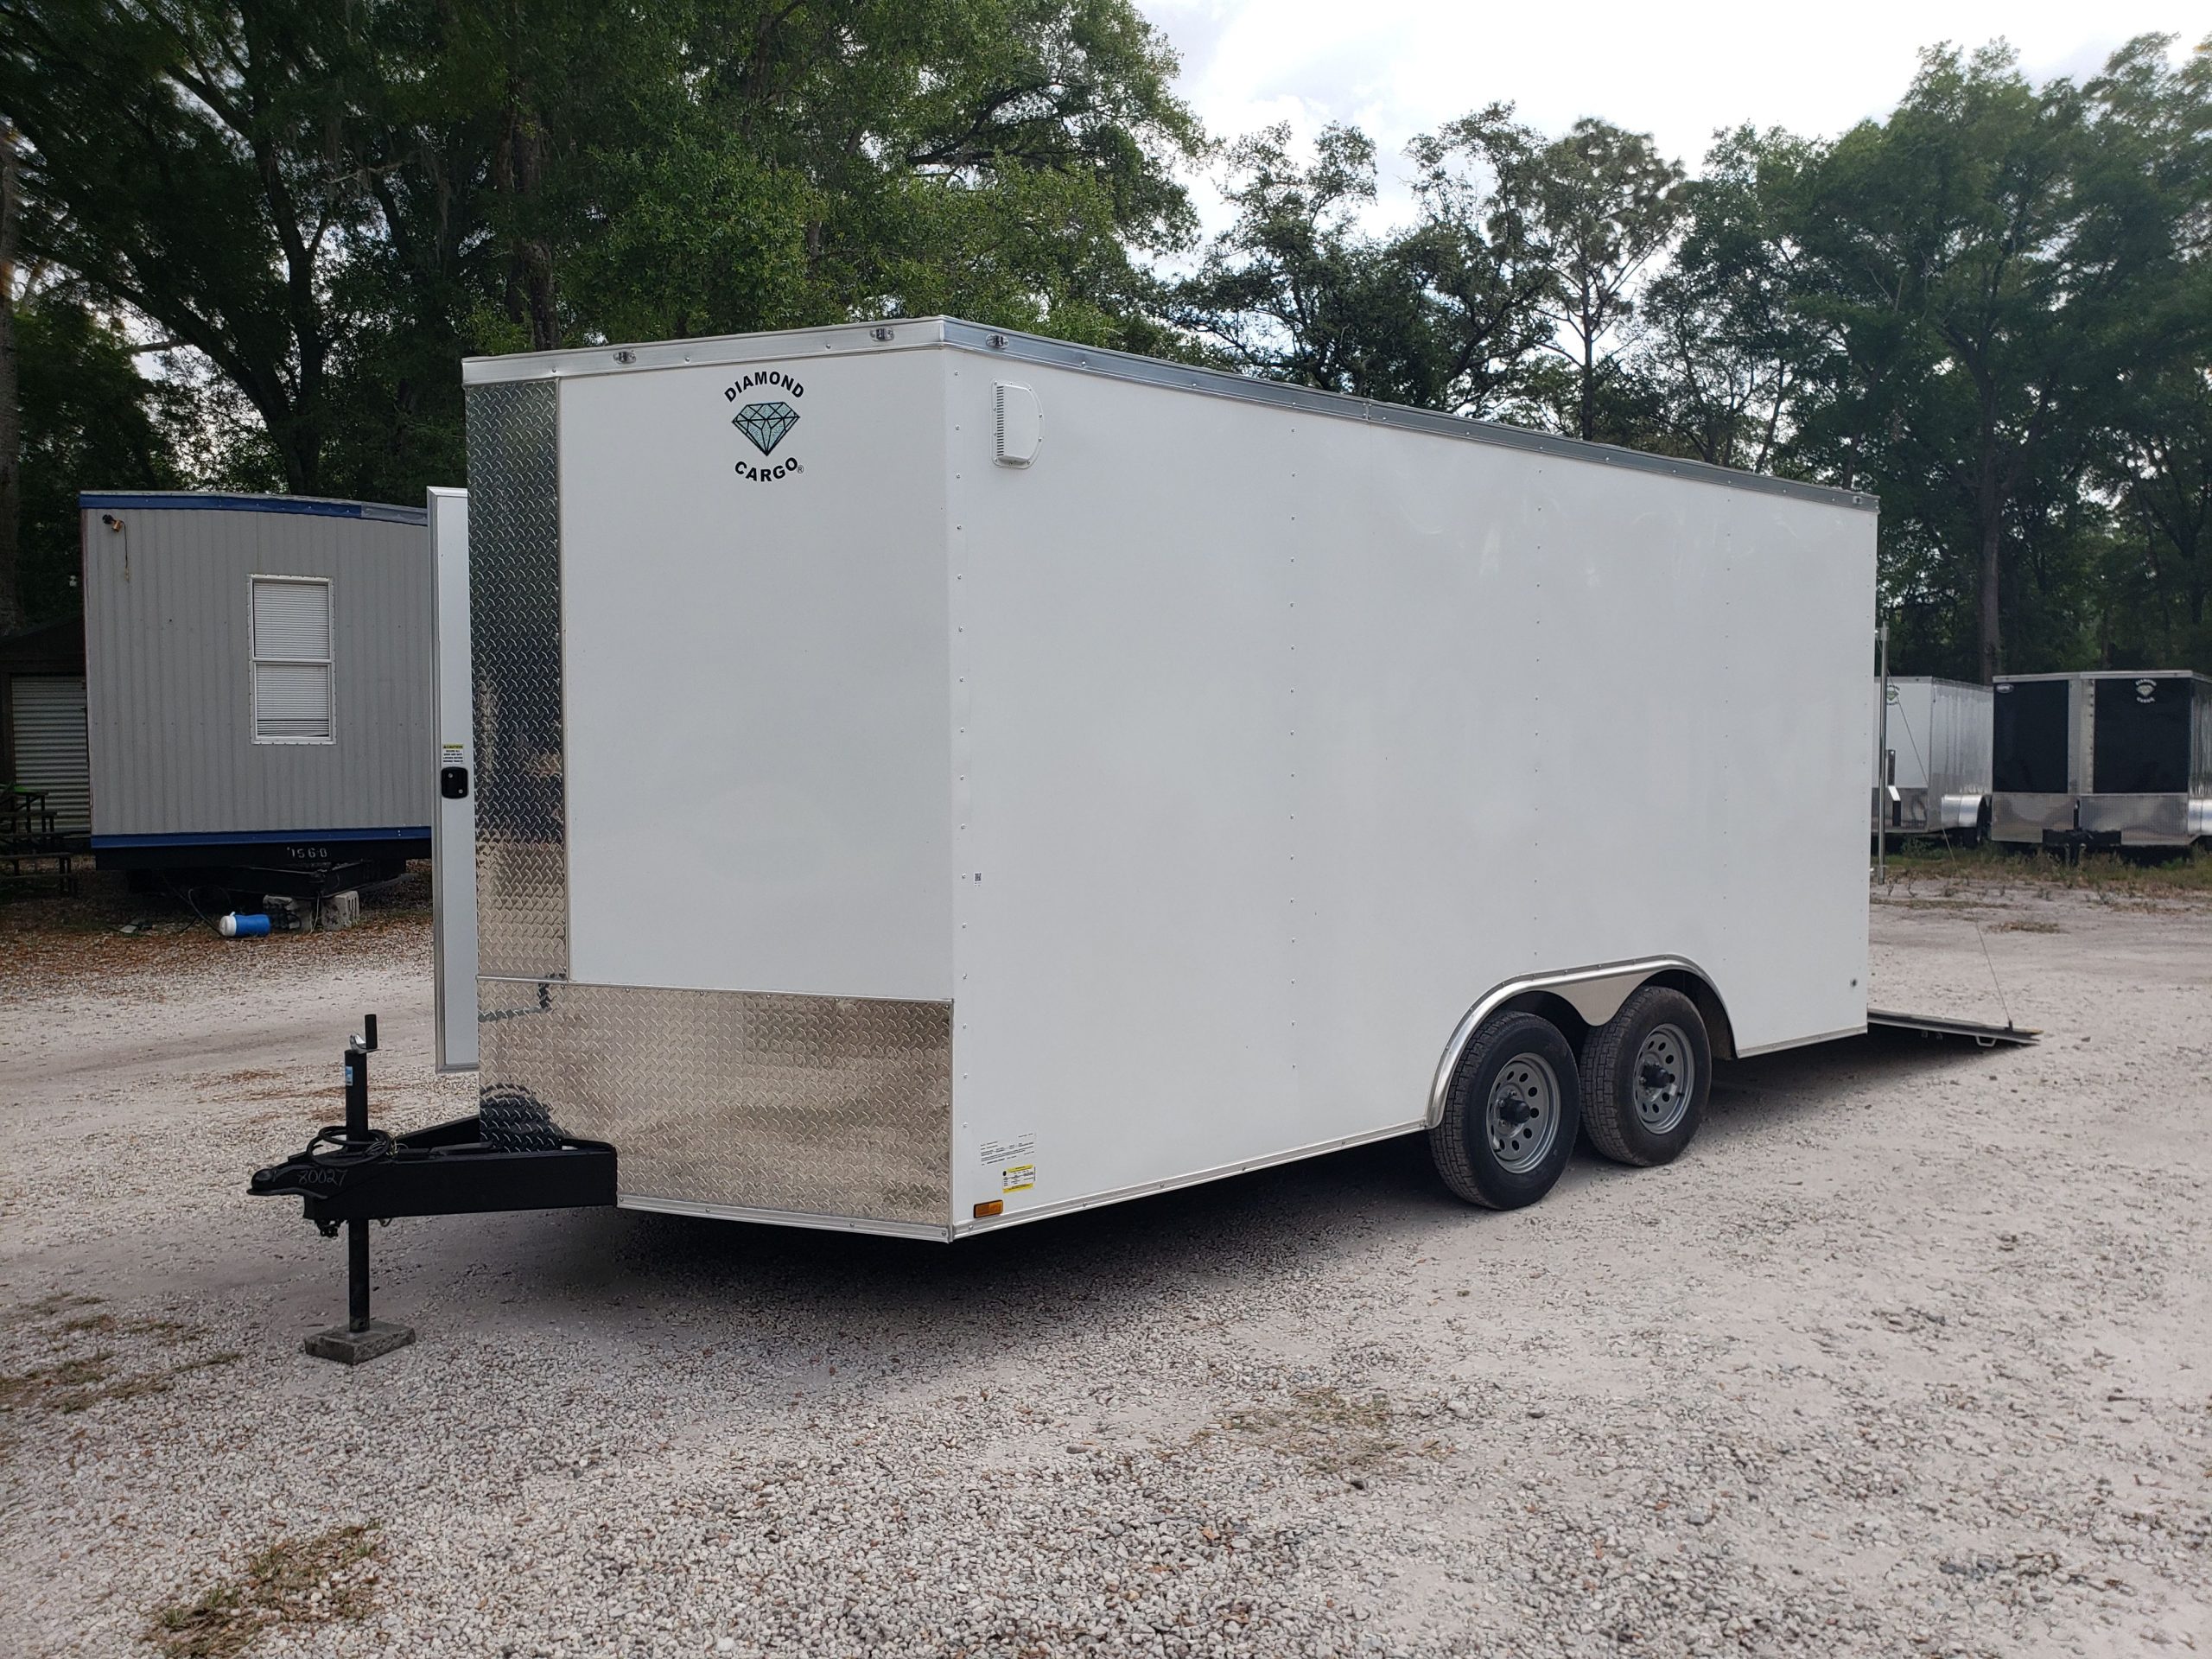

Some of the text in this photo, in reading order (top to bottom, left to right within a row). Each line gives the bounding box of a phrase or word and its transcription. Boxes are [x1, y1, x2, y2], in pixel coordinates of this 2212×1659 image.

[724, 371, 804, 403] DIAMOND
[734, 457, 798, 482] CARGO
[297, 1168, 347, 1187] 80027
